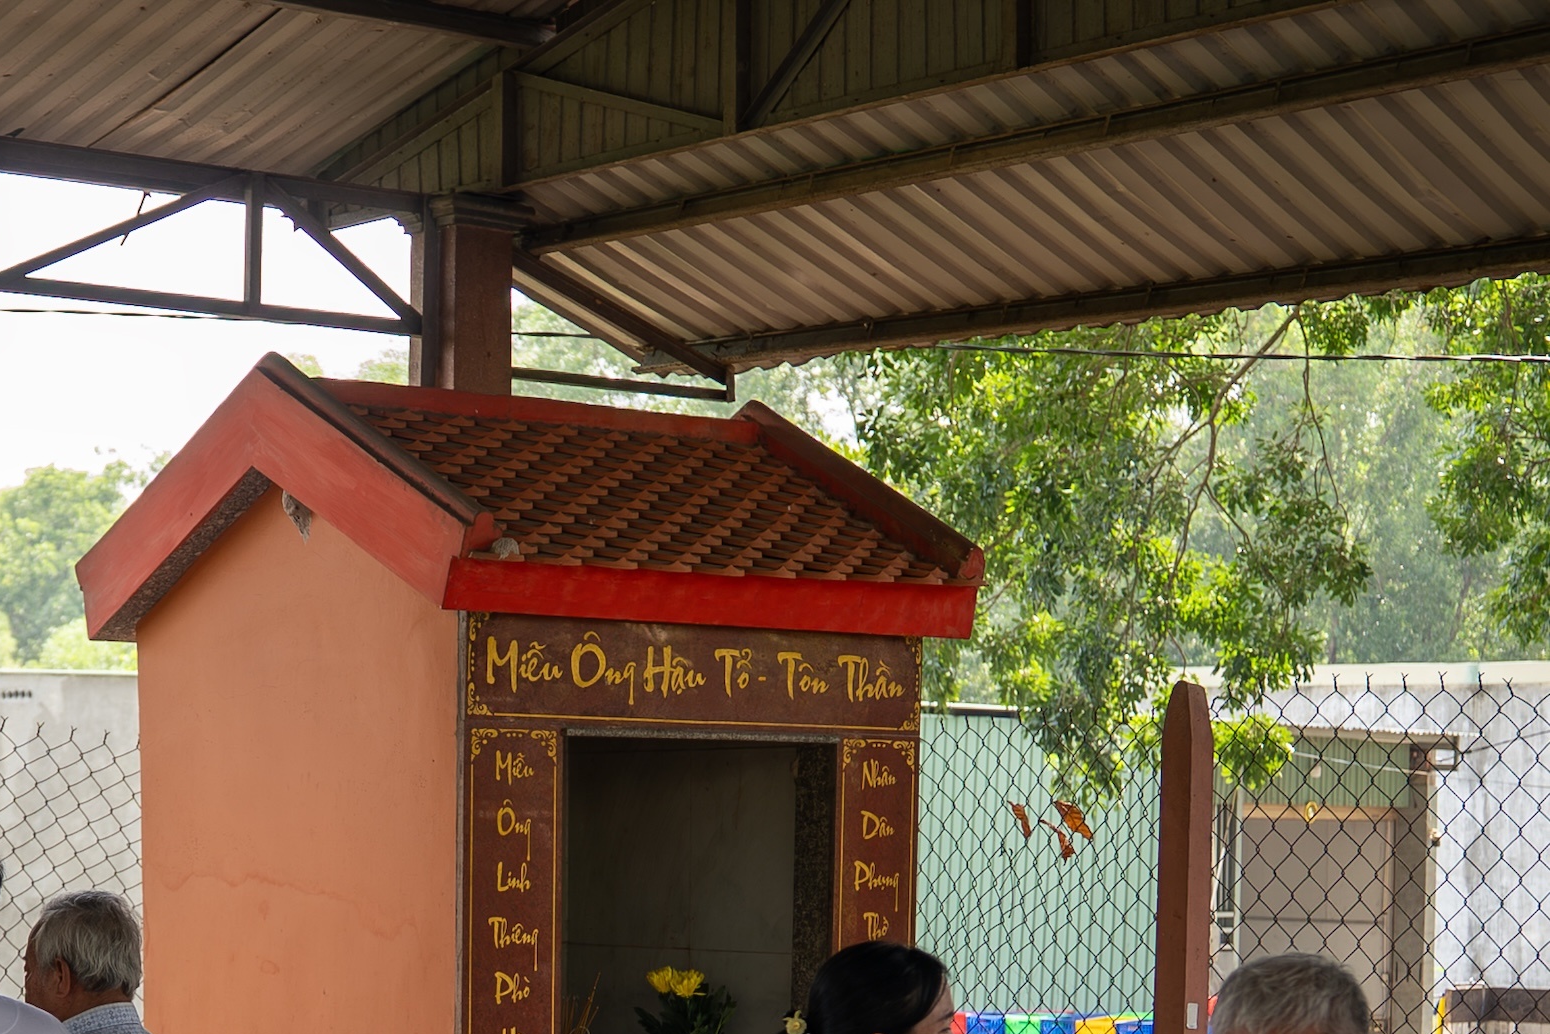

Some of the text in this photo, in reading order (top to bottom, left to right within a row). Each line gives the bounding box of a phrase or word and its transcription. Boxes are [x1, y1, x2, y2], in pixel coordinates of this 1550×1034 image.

[570, 630, 637, 705] Ông
[642, 645, 707, 698] Hậu
[714, 647, 753, 697] Tổ
[776, 651, 830, 699] Tôn
[837, 654, 905, 703] Thần
[862, 759, 896, 788] Nhân
[496, 799, 531, 861] Ông
[860, 810, 895, 840] Dân
[496, 861, 531, 893] Linh
[853, 860, 899, 913] Phụng
[487, 916, 539, 971] Thiêng
[494, 971, 531, 1005] Phò
